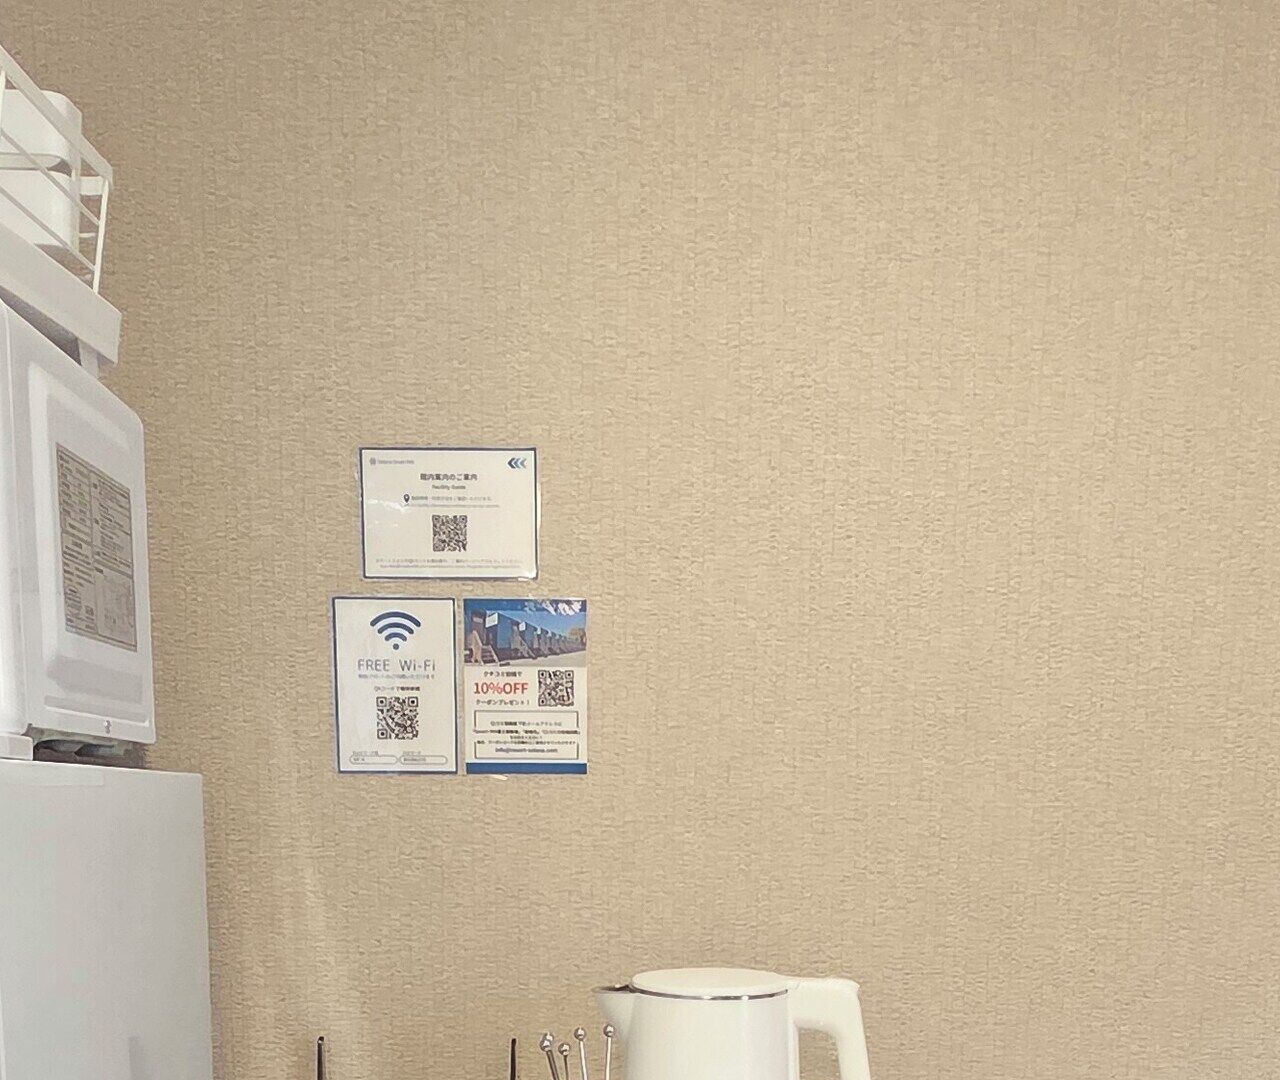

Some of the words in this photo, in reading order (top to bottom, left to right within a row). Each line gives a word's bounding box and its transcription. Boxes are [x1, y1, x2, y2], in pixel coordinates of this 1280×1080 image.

[357, 658, 390, 672] FREE
[399, 658, 436, 672] Wi-Fi
[474, 682, 529, 695] 10%OFF
